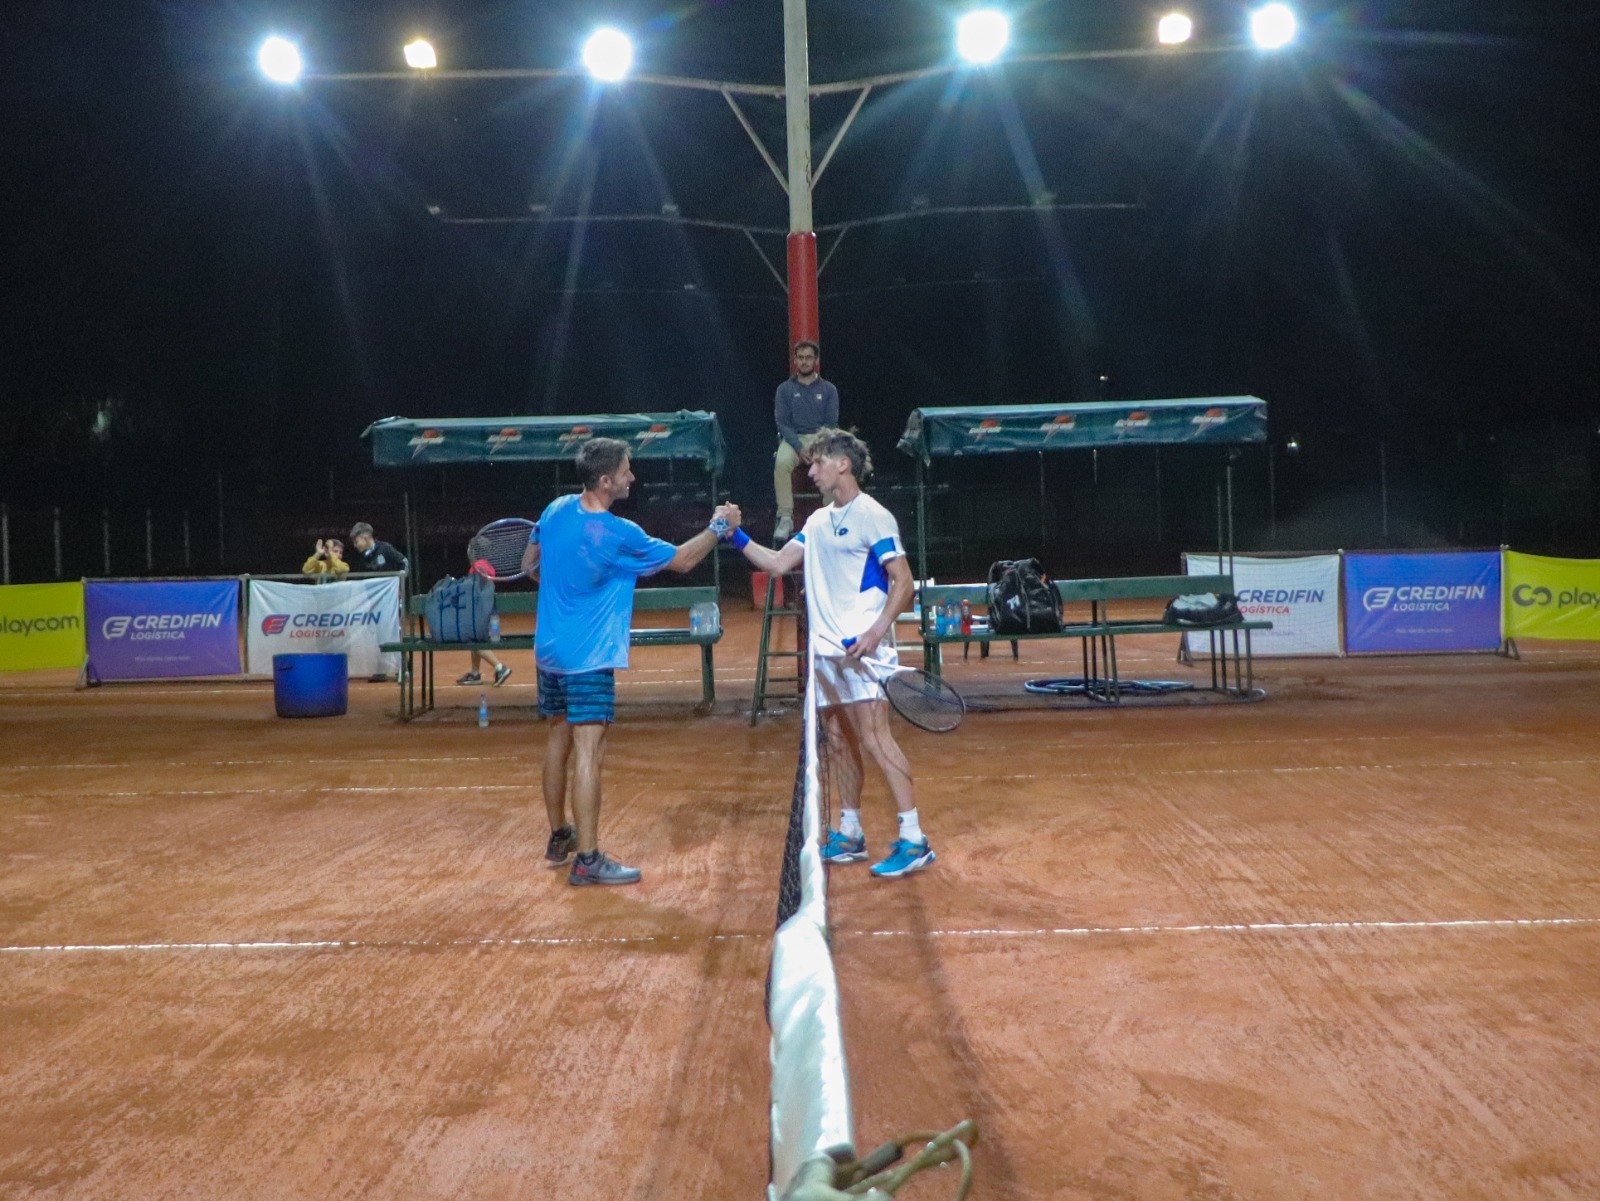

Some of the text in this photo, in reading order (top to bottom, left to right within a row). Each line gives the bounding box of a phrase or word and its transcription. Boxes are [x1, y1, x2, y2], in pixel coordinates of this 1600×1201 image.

[1238, 589, 1324, 603] CREDIFIN
[1396, 585, 1485, 600] CREDIFIN
[1239, 605, 1290, 614] OGÍSTICA
[0, 615, 79, 637] laycom
[133, 613, 222, 629] CREDIFIN
[292, 612, 382, 627] CREDIFIN
